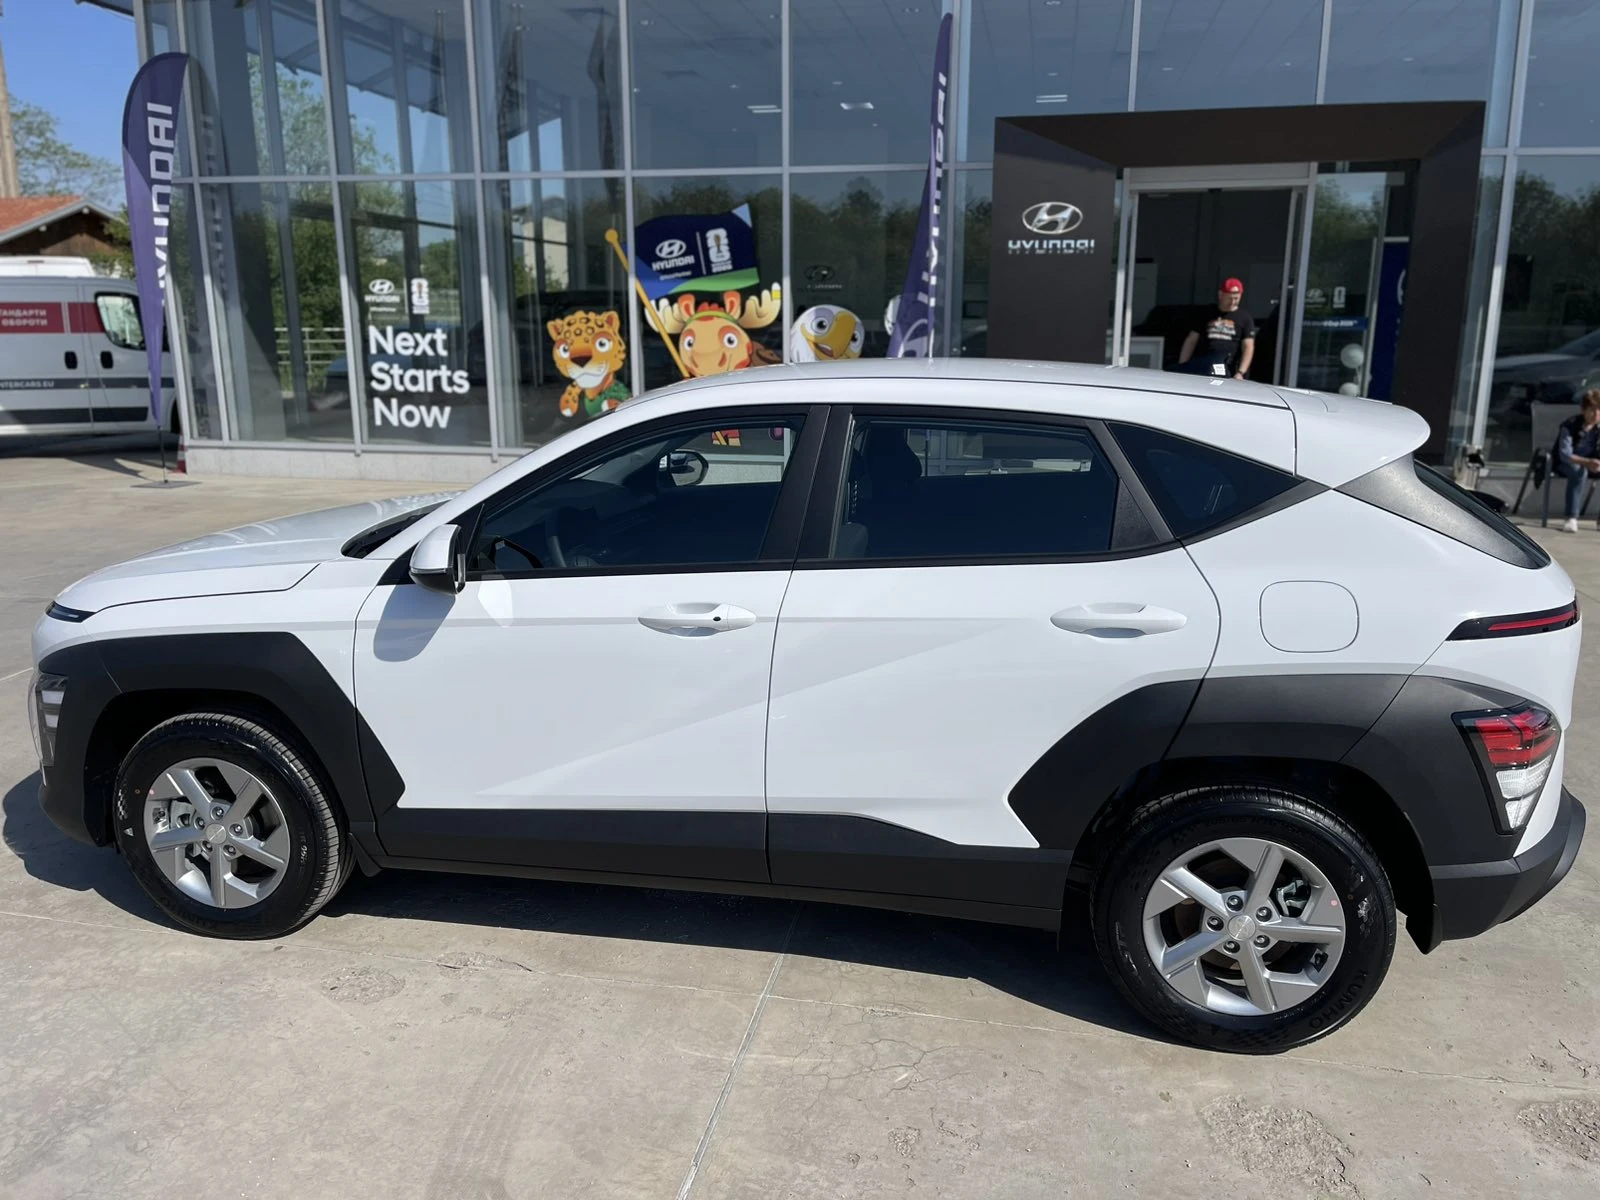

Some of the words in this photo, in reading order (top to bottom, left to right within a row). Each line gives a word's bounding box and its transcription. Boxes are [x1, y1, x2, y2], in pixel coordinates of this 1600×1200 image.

[652, 255, 695, 271] HYUNDAI
[364, 295, 400, 303] HYUNDAI
[368, 324, 449, 357] Next
[370, 361, 471, 394] Starts
[373, 397, 451, 429] Now
[1310, 970, 1369, 1028] KUMHO
